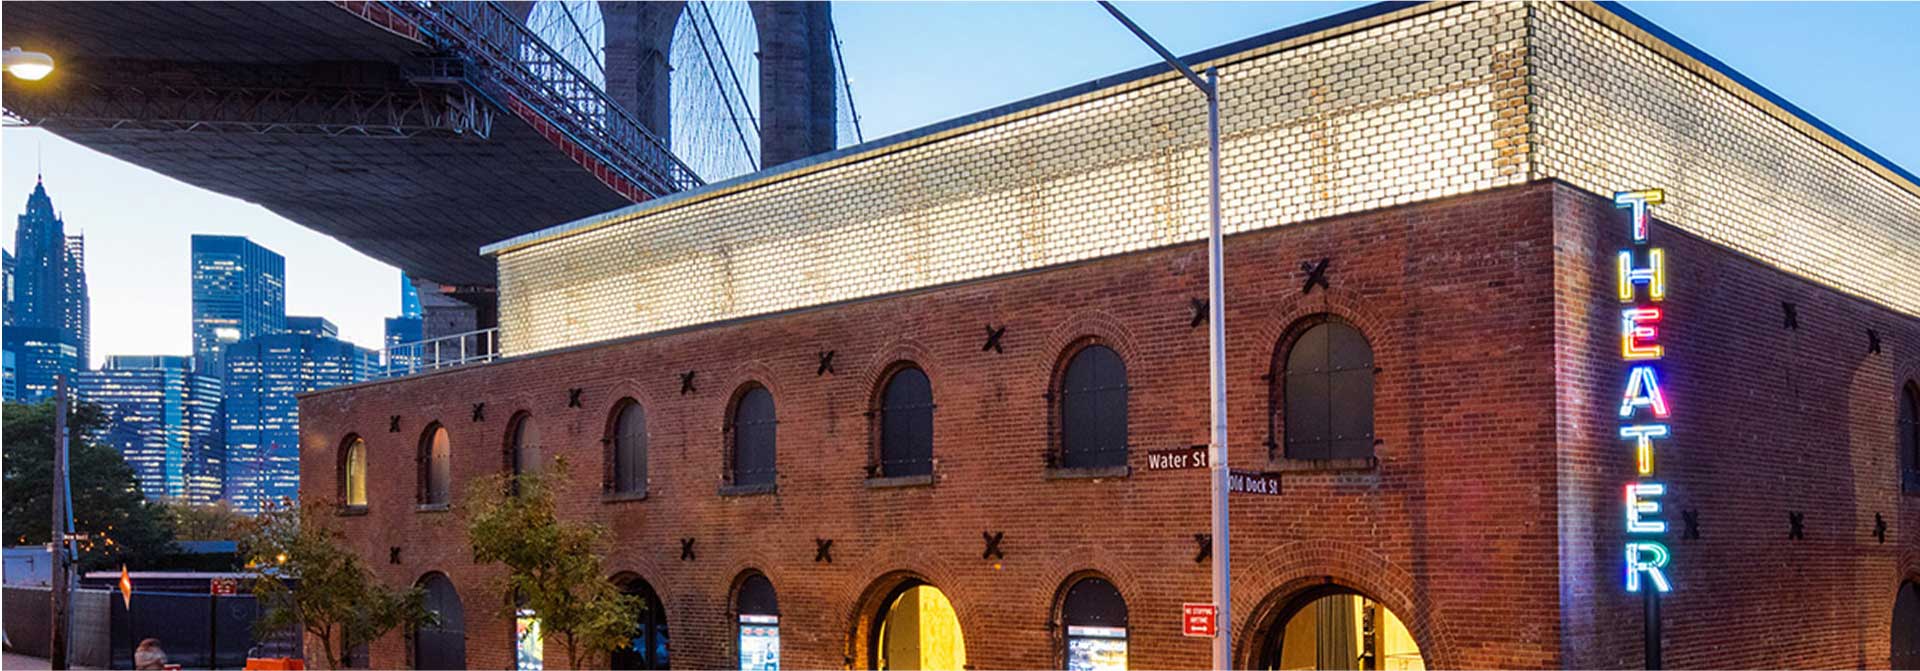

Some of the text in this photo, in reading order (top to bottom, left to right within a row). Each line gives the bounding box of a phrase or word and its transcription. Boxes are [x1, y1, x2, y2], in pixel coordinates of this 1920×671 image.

[1614, 188, 1672, 593] THEATER
[1149, 451, 1206, 469] Water St
[1229, 475, 1278, 494] Old Dock St
